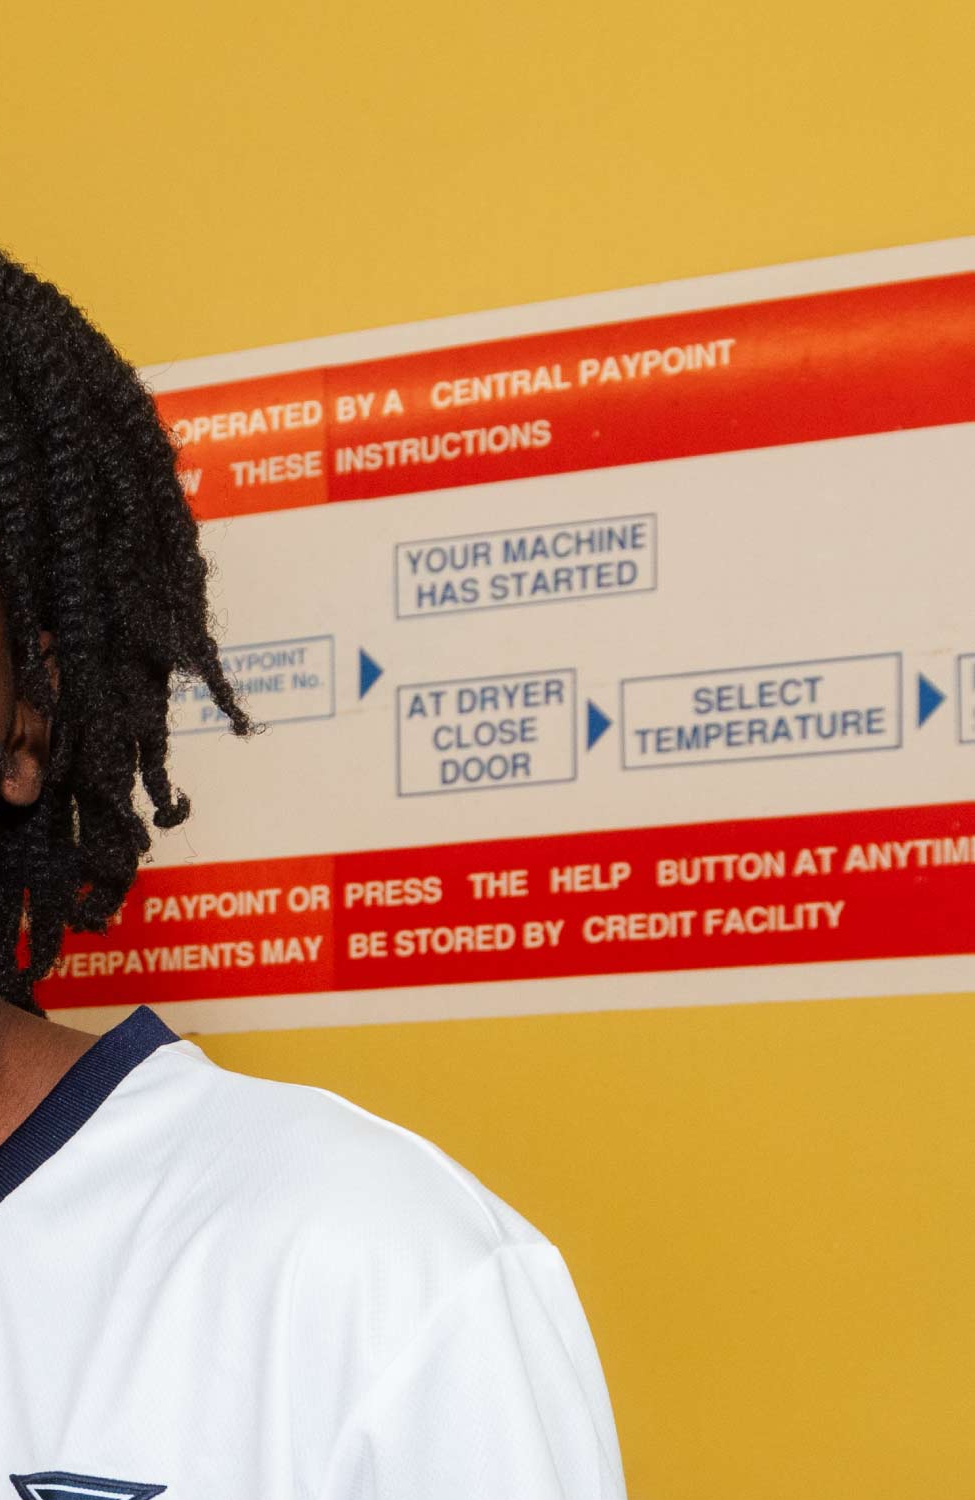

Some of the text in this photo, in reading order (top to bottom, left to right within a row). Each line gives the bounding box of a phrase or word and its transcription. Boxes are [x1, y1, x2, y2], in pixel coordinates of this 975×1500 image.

[171, 338, 735, 445] OPERATED BY A CENTRAL PAYPOINT
[229, 450, 323, 488] THESE
[335, 420, 552, 474] INSTRUCTIONS
[407, 523, 647, 575] YOUR MACHINE
[416, 560, 638, 608] HAS STARTED
[221, 649, 304, 670] AYPOINT
[407, 679, 564, 719] AT DRYER
[694, 676, 823, 715] SELECT
[433, 717, 537, 751] CLOSE
[635, 707, 886, 754] TEMPERATURE
[440, 752, 531, 785] DOOR
[143, 888, 281, 922] PAYPOINT
[287, 885, 330, 914] OR
[345, 876, 442, 909] PRESS
[467, 869, 529, 900] THE
[549, 861, 631, 895] HELP
[656, 850, 786, 889] BUTTON
[793, 846, 838, 878] AT
[843, 835, 975, 873] ANYTIM
[56, 900, 845, 978] VERPAYMENTS MAY BE STORED BY CREDIT FACILITY
